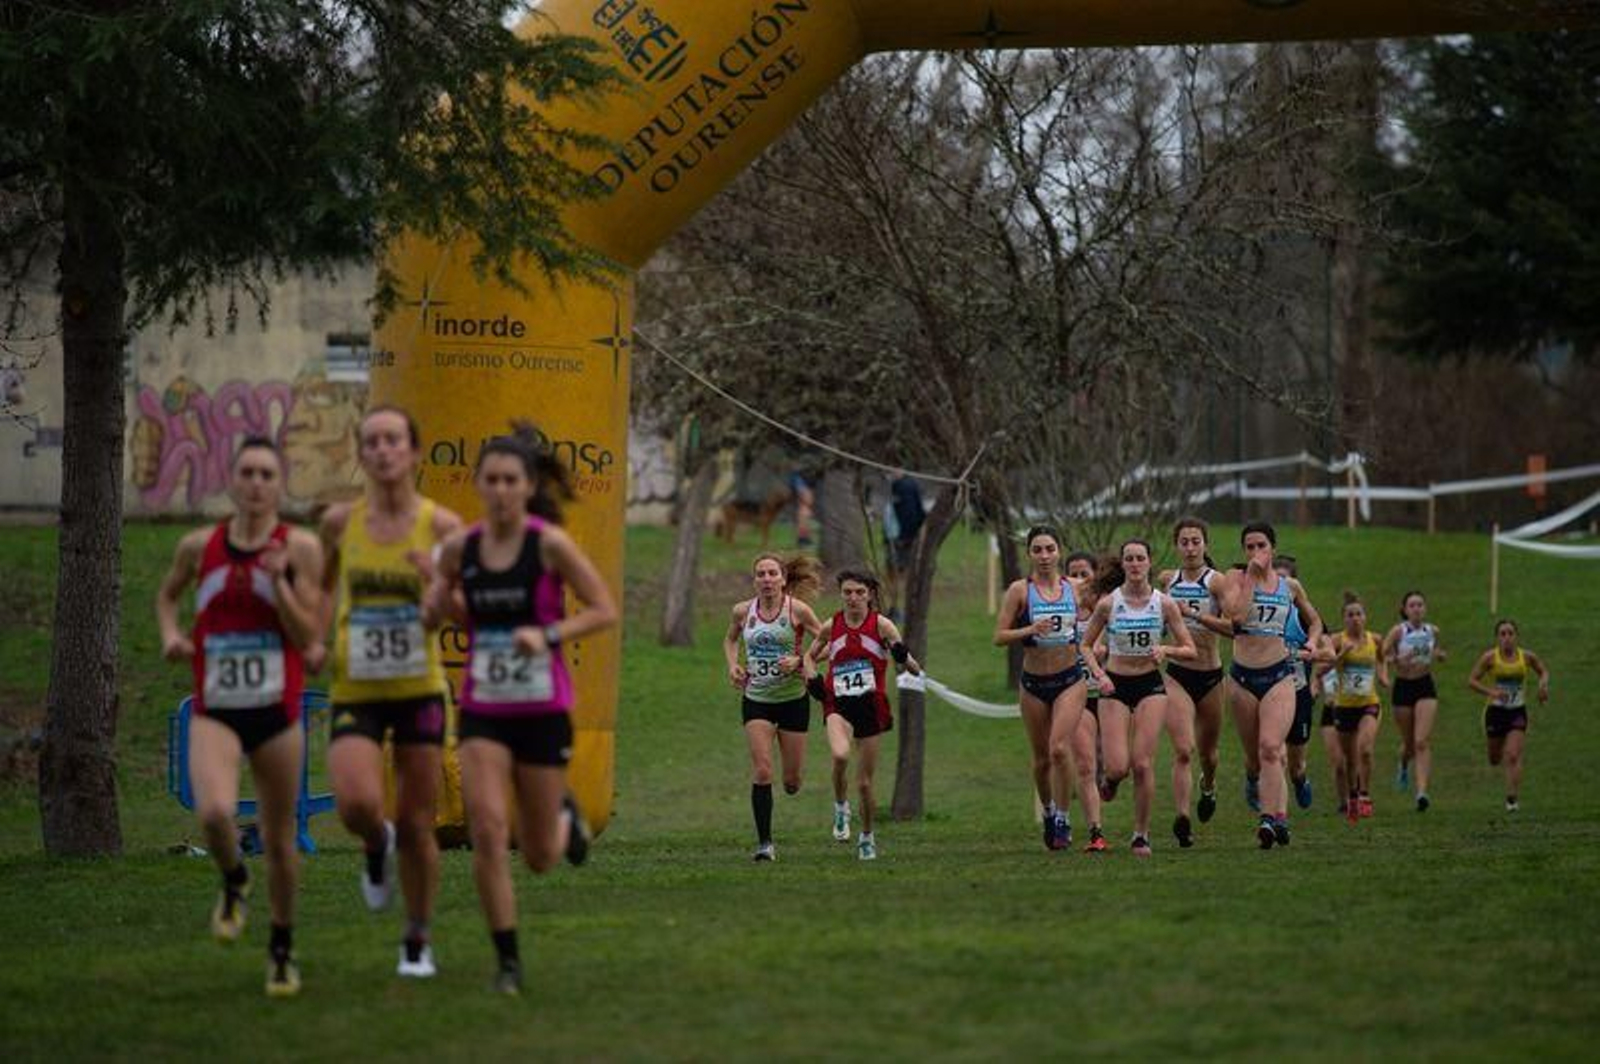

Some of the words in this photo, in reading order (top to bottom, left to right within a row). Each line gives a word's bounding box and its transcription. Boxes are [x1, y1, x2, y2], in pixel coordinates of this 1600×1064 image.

[590, 0, 810, 195] DEPUTACIÓN
[649, 45, 806, 194] OURENSE
[435, 313, 527, 339] inorde
[434, 349, 503, 369] turismo
[508, 351, 585, 373] Ourense
[1257, 605, 1278, 624] 17
[364, 626, 411, 662] 35
[1127, 630, 1151, 648] 18
[217, 654, 266, 690] 30
[487, 651, 533, 685] 62
[842, 672, 867, 691] 14
